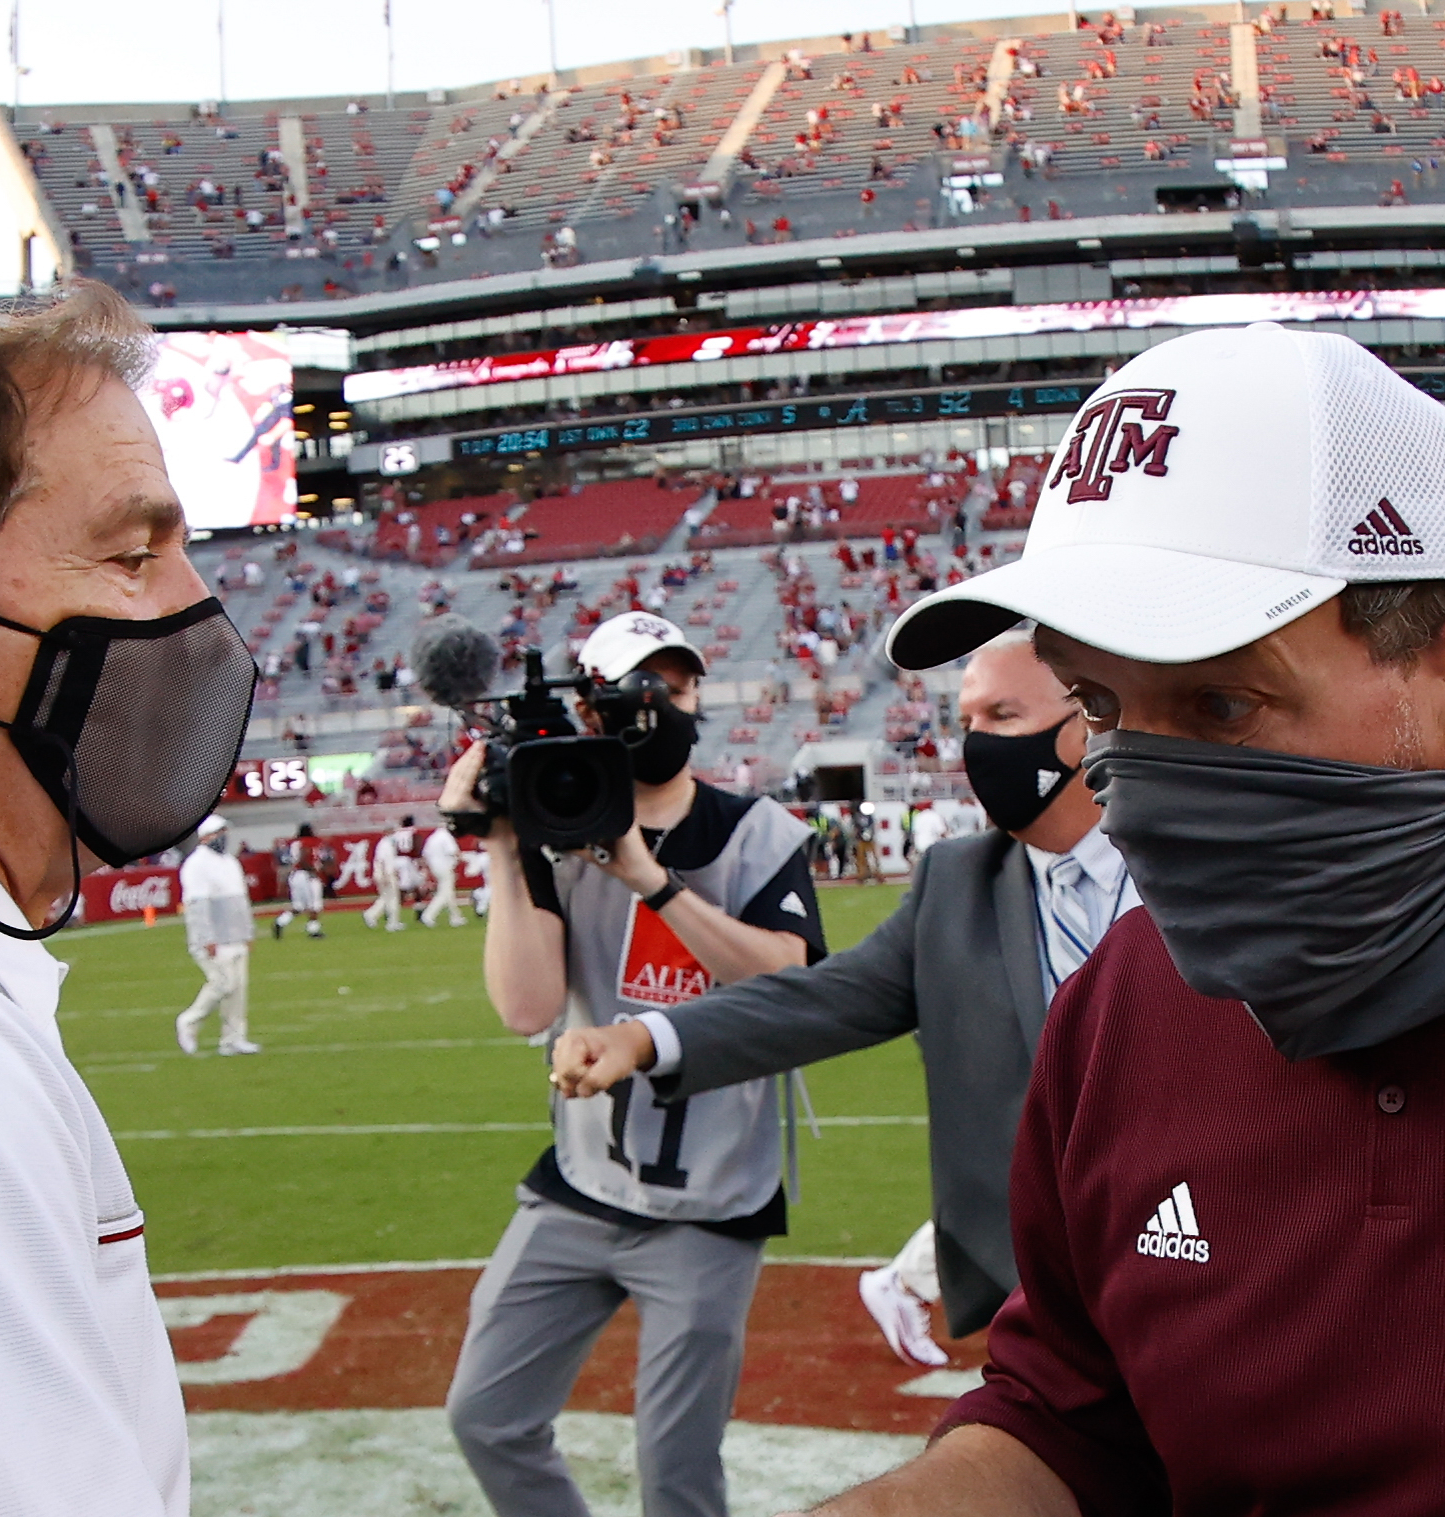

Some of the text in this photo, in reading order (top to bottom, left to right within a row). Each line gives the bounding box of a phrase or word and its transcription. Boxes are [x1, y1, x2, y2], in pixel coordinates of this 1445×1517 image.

[939, 390, 972, 414] 52
[1007, 387, 1025, 409] 4
[383, 446, 416, 471] 25
[1347, 535, 1425, 557] adidas
[1264, 586, 1313, 620] AEROREADY
[269, 761, 307, 791] 25
[110, 876, 172, 913] Coca-Cola
[1137, 1230, 1210, 1263] adidas
